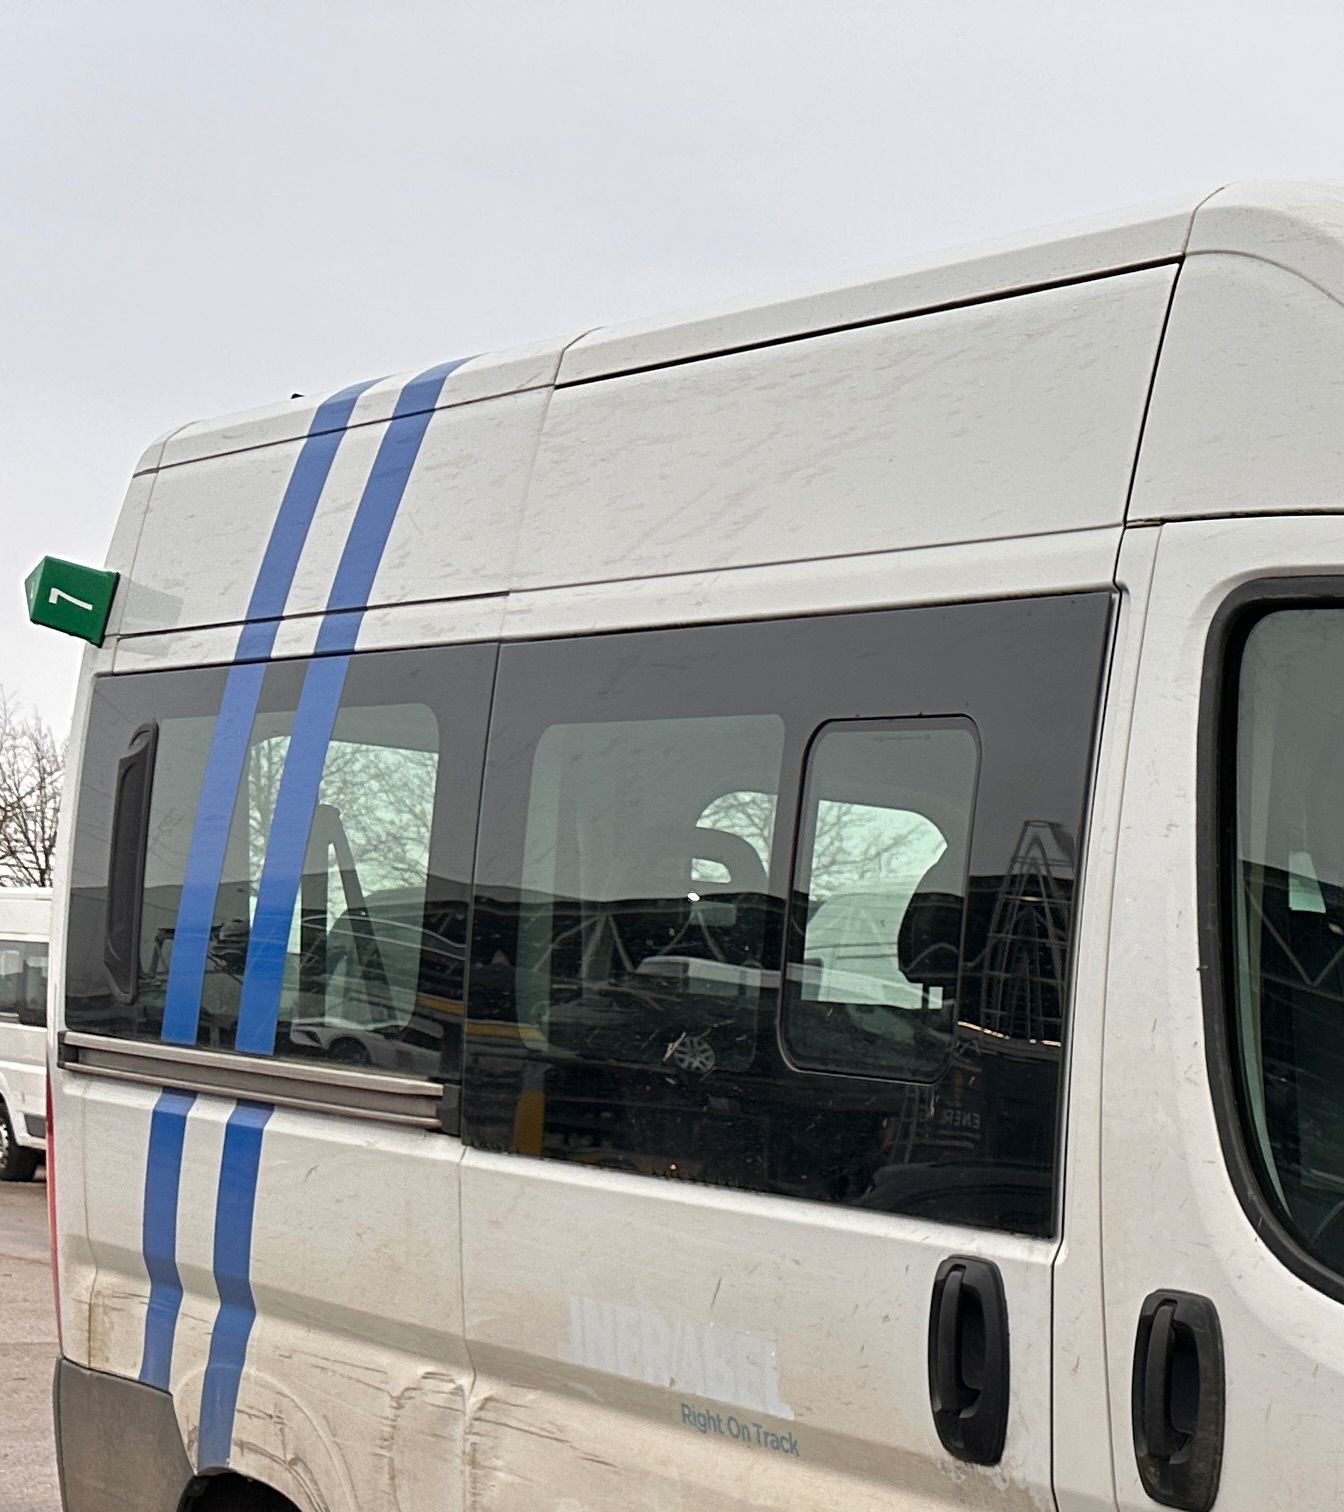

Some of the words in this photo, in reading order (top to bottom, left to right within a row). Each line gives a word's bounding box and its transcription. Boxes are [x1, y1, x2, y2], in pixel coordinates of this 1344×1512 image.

[681, 1402, 724, 1435] Right
[728, 1415, 750, 1441] On
[752, 1423, 801, 1457] Track
